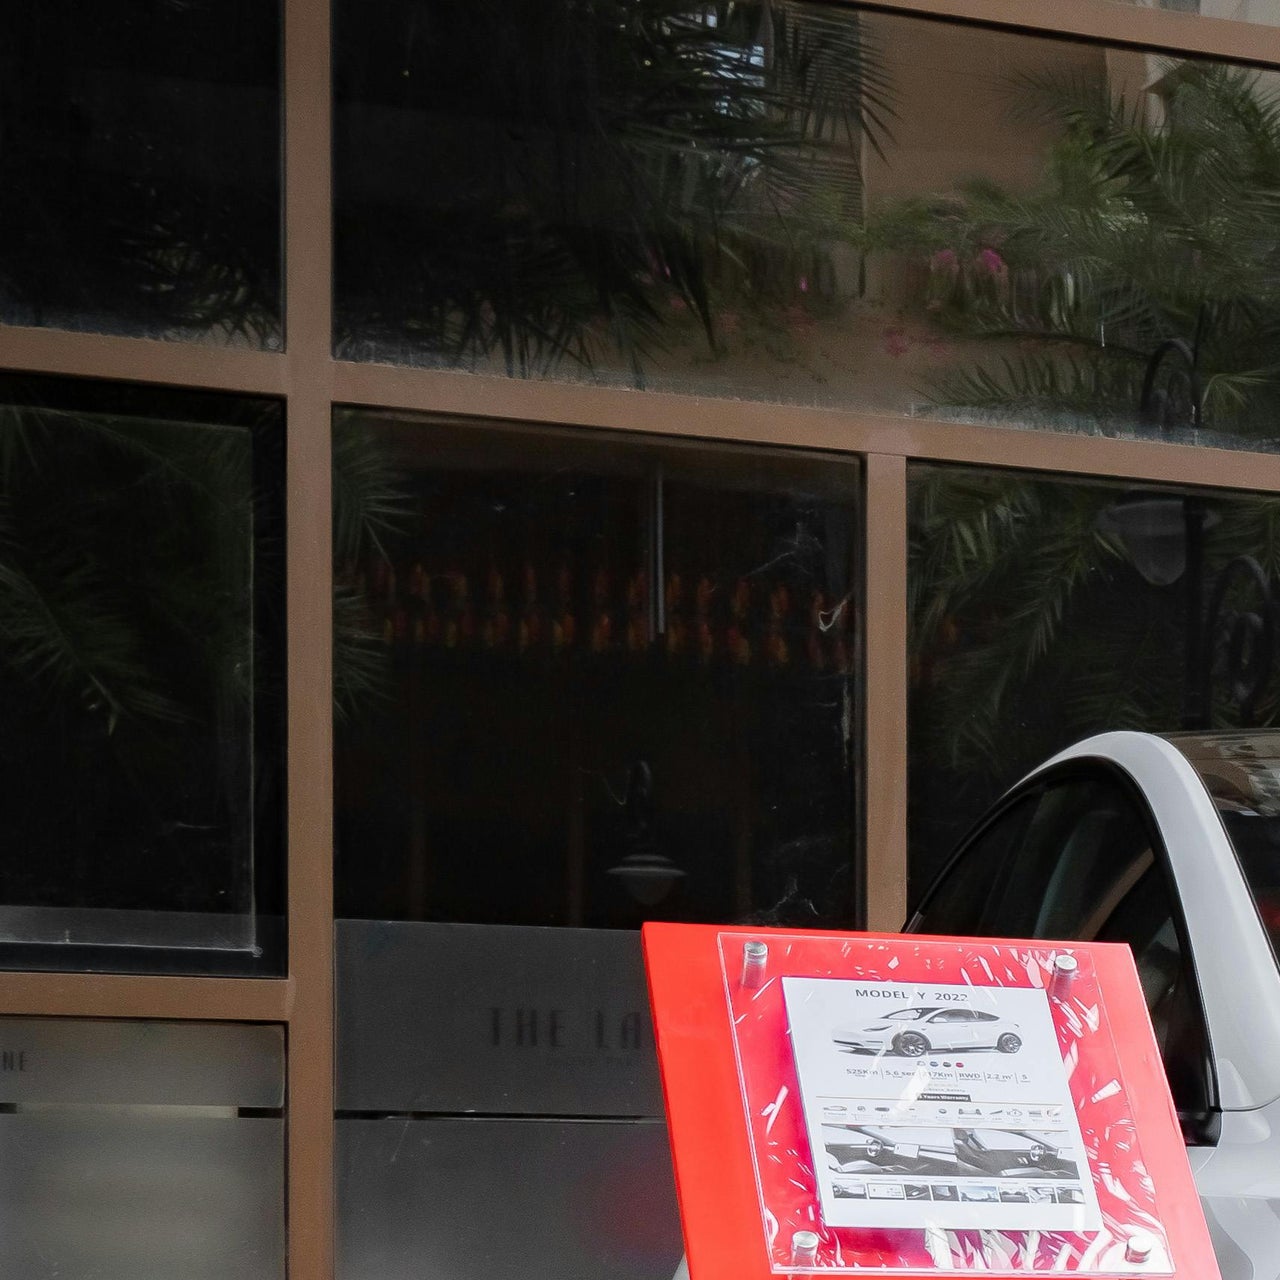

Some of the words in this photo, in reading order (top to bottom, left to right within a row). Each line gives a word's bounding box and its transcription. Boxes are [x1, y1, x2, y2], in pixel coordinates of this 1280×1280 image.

[855, 989, 910, 999] MODEL
[917, 991, 926, 1000] Y
[934, 992, 969, 1001] 2022
[488, 1007, 565, 1048] THE
